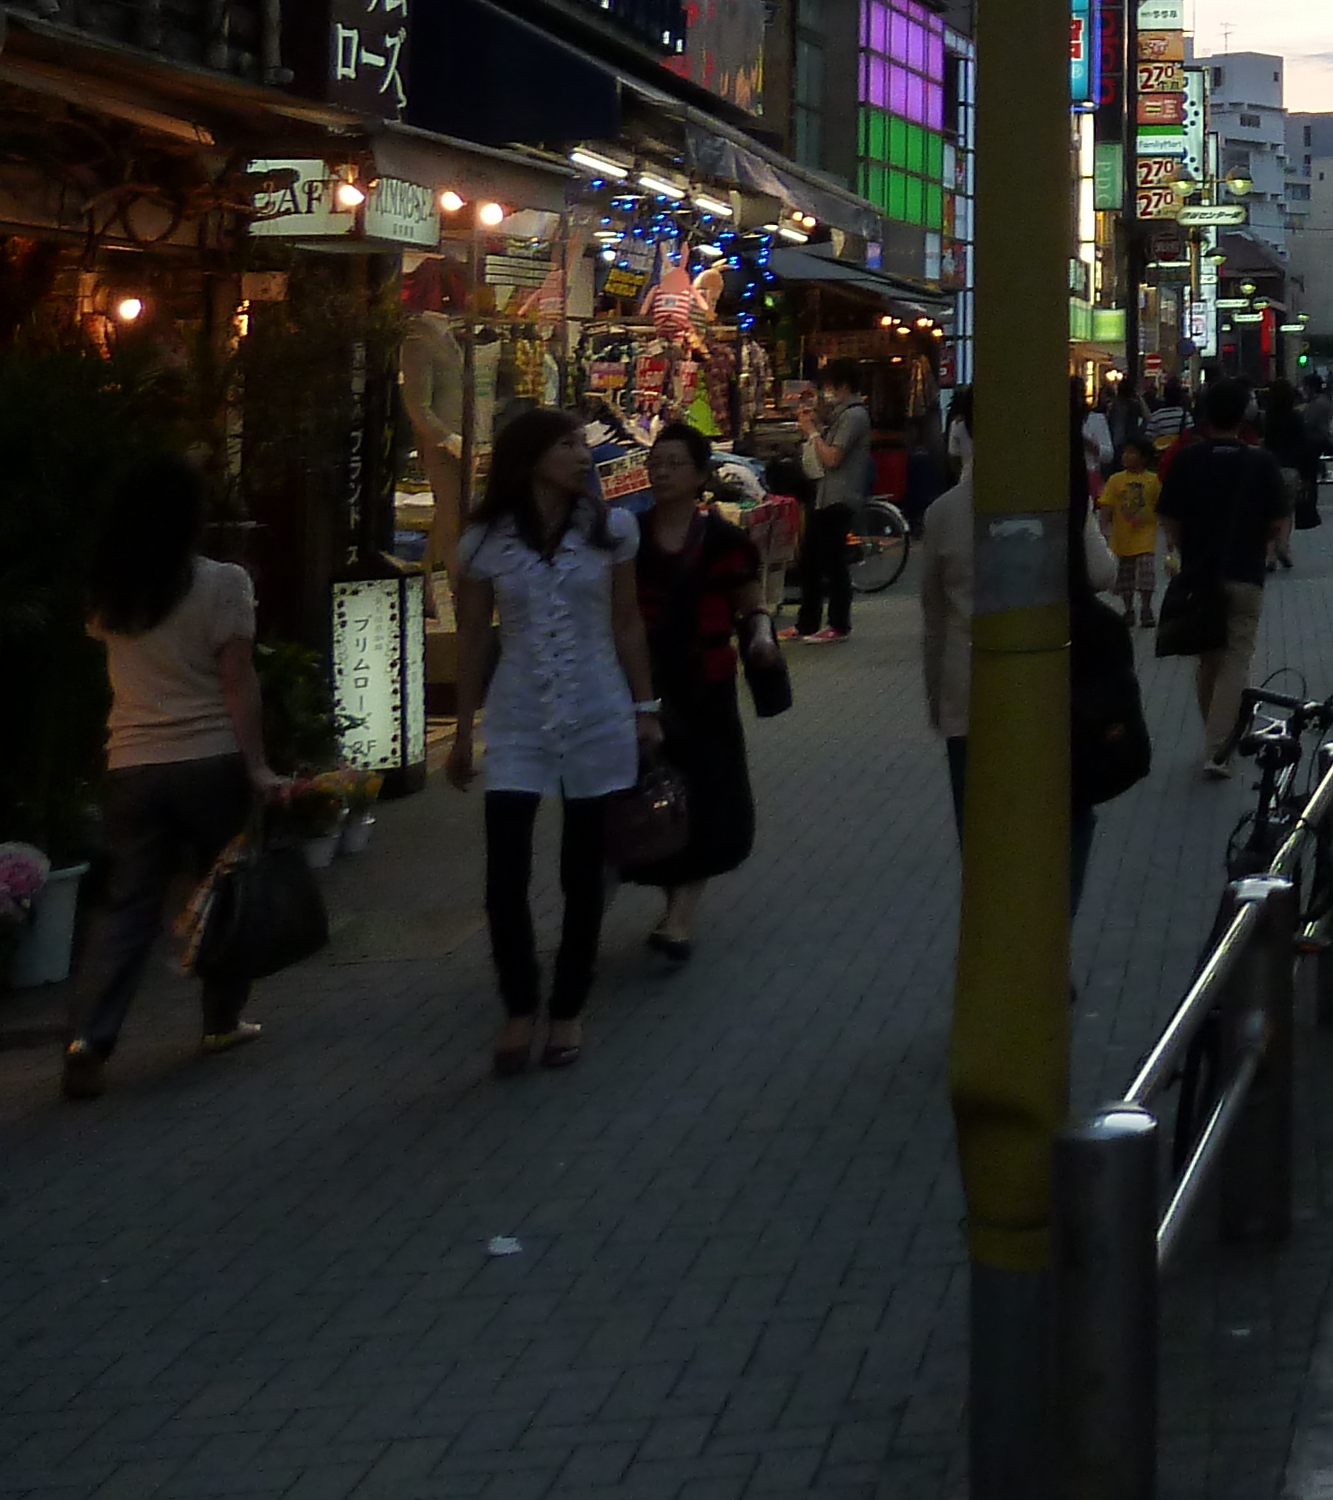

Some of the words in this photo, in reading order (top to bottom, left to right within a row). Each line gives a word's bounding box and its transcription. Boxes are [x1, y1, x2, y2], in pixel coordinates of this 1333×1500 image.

[336, 22, 409, 110] ローズ
[1139, 65, 1175, 91] 270
[1138, 159, 1174, 186] 270
[1138, 191, 1174, 217] 270
